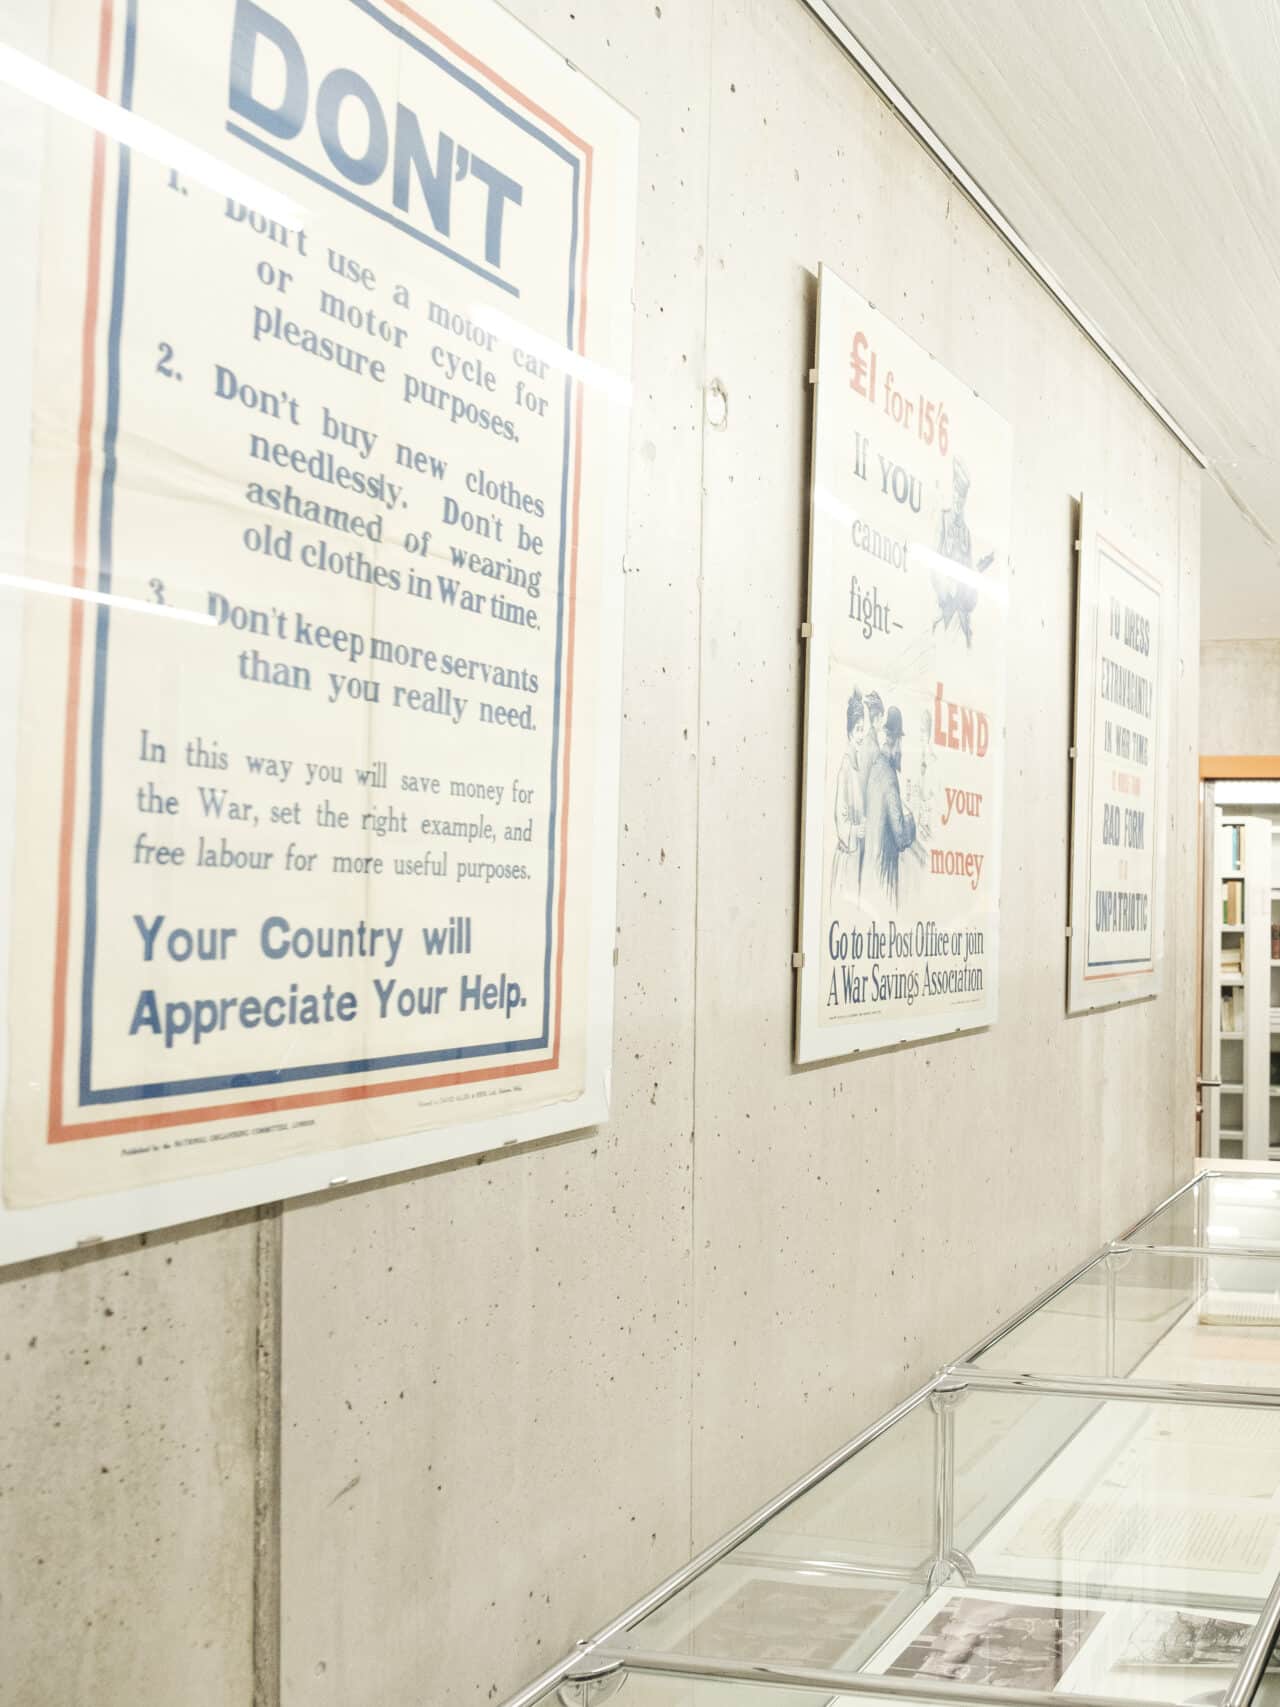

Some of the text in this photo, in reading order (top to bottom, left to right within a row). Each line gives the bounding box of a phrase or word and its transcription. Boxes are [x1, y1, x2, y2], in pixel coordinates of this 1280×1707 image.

[228, 0, 523, 269] DON'T
[224, 196, 308, 256] Dont
[327, 247, 375, 291] use
[392, 283, 411, 310] a
[428, 299, 498, 353] motor
[512, 346, 551, 382] car
[253, 305, 519, 444] pleasure purposes.
[257, 260, 548, 418] or motor cycle for
[850, 331, 876, 402] £1
[884, 370, 913, 427] for
[156, 341, 545, 518] 2. Don't buy new clothes
[250, 432, 544, 556] needlessly. Don't be
[853, 430, 922, 514] If YOU
[243, 523, 292, 562] old
[301, 536, 400, 592] clothes
[407, 561, 432, 598] in
[245, 479, 542, 598] ashamed of wearing
[852, 519, 908, 573] cannot
[149, 578, 539, 694] 3 Don't keep more servants
[237, 651, 536, 730] than you really need.
[934, 681, 989, 759] LEND
[139, 730, 533, 805] In this way you will save money for
[137, 785, 532, 842] the War, set the right example, and
[942, 787, 982, 825] your
[1103, 803, 1144, 850] BAD FORM
[134, 833, 530, 883] free labour for more useful purposes.
[931, 849, 984, 890] money
[134, 915, 471, 967] Your Country will
[829, 919, 984, 965] Go to the Post Office or join
[1096, 890, 1148, 932] UNPATRIOTIC
[129, 974, 527, 1048] Appreciate Your Help.
[827, 962, 983, 1006] A War Savings Association
